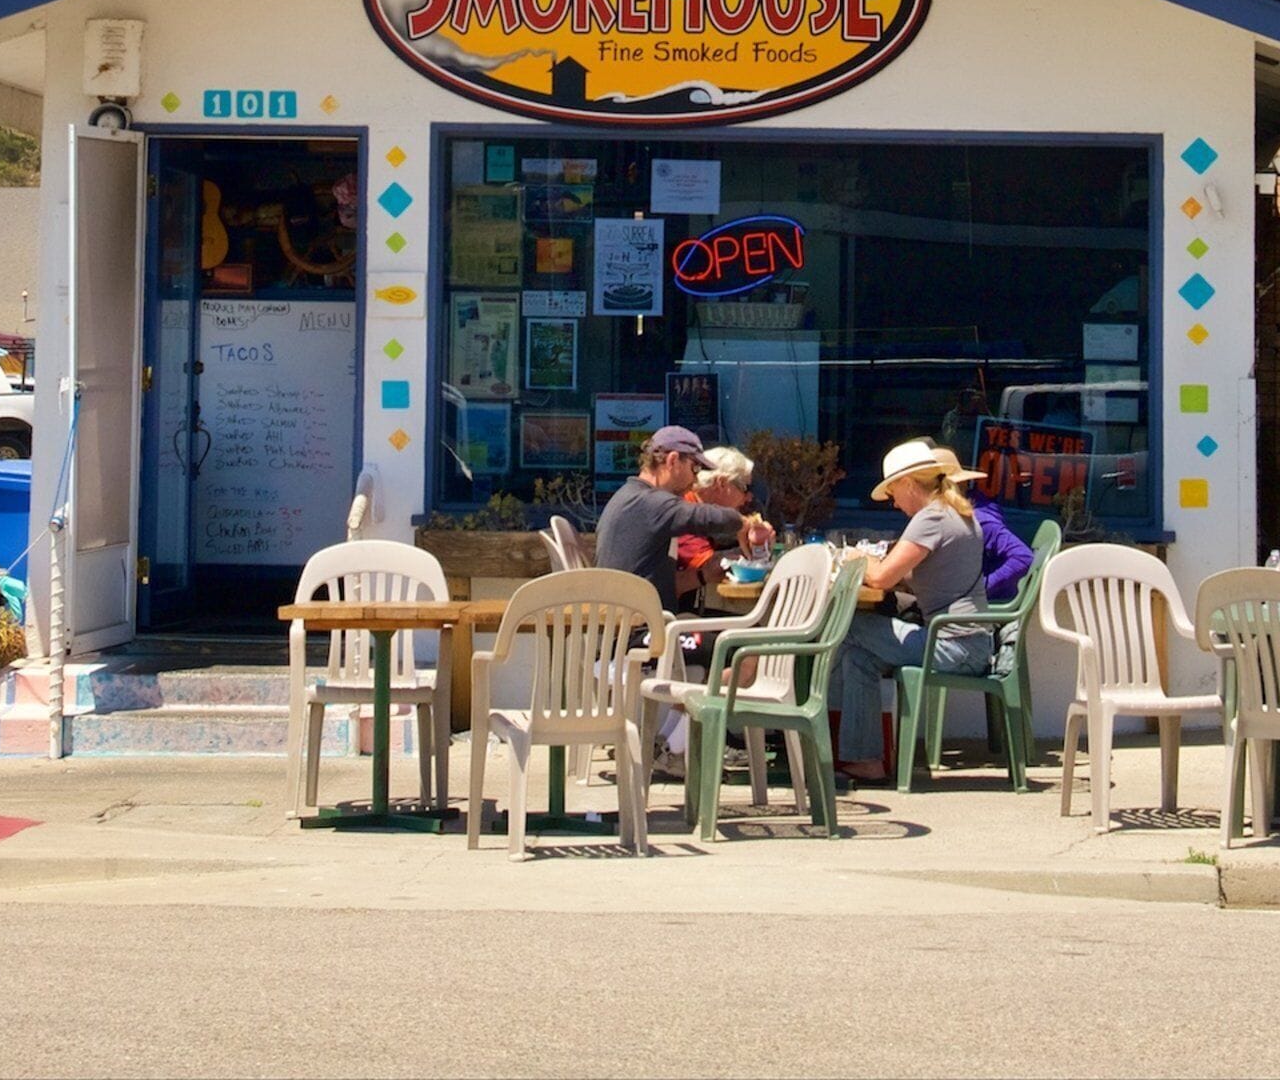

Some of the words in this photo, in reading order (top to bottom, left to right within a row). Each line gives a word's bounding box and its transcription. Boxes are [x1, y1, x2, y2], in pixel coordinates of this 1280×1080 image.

[598, 39, 644, 62] Fine
[653, 40, 740, 62] Smoked
[752, 41, 818, 63] Foods
[210, 92, 289, 117] 101
[672, 226, 804, 281] OPEN
[299, 312, 351, 329] MENU
[210, 342, 275, 362] TACOS
[984, 426, 1021, 448] YES
[977, 450, 1087, 505] OPEN
